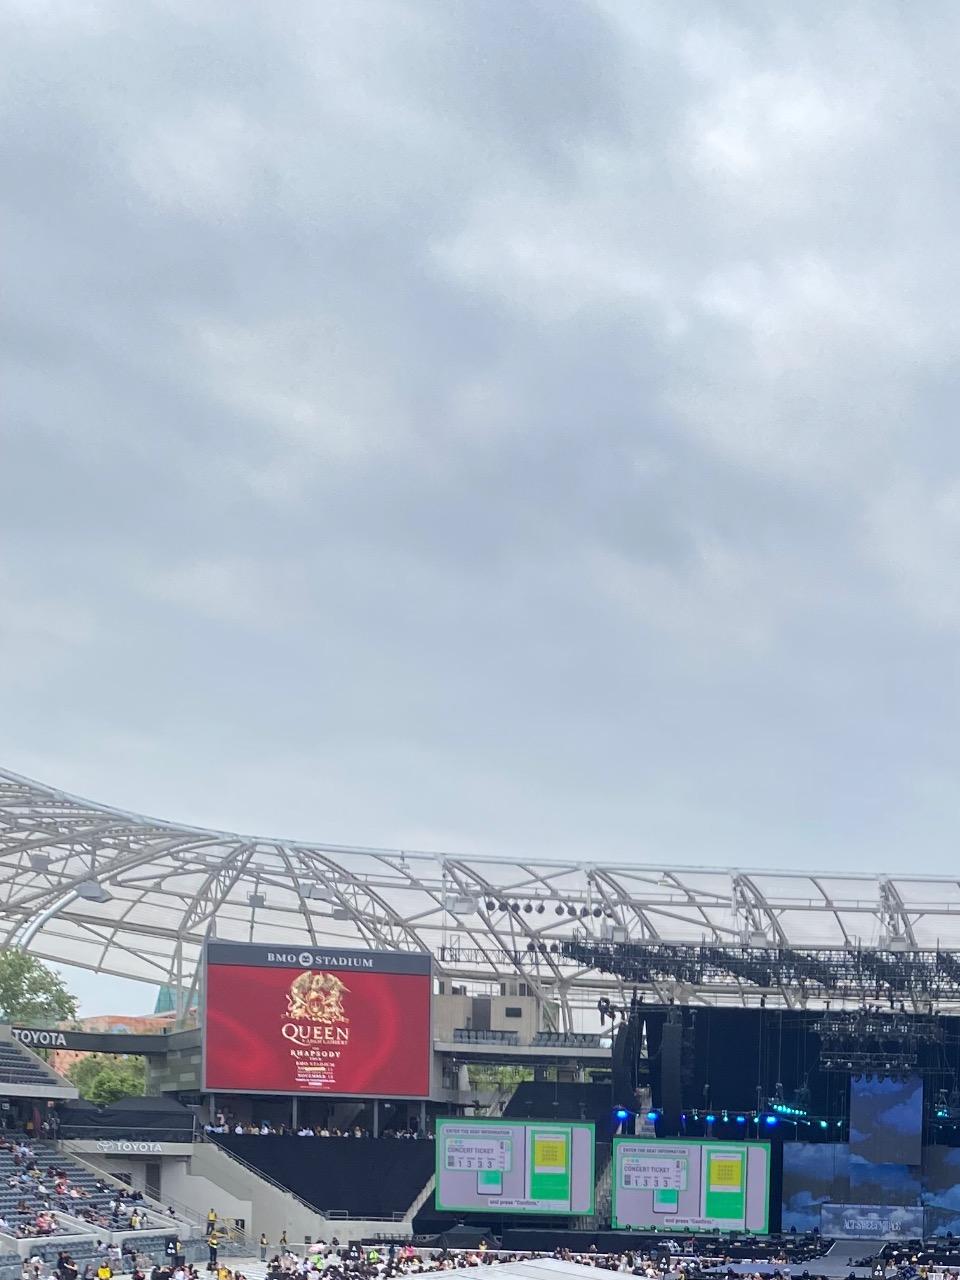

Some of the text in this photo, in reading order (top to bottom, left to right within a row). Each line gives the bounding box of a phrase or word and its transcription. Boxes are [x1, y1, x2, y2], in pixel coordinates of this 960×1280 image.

[267, 952, 373, 967] BMO STADIUM
[12, 1029, 67, 1046] TOYOTA
[281, 1023, 350, 1047] QUEEN
[290, 1049, 341, 1059] RHAPSODY
[117, 1142, 163, 1152] TOYOTA
